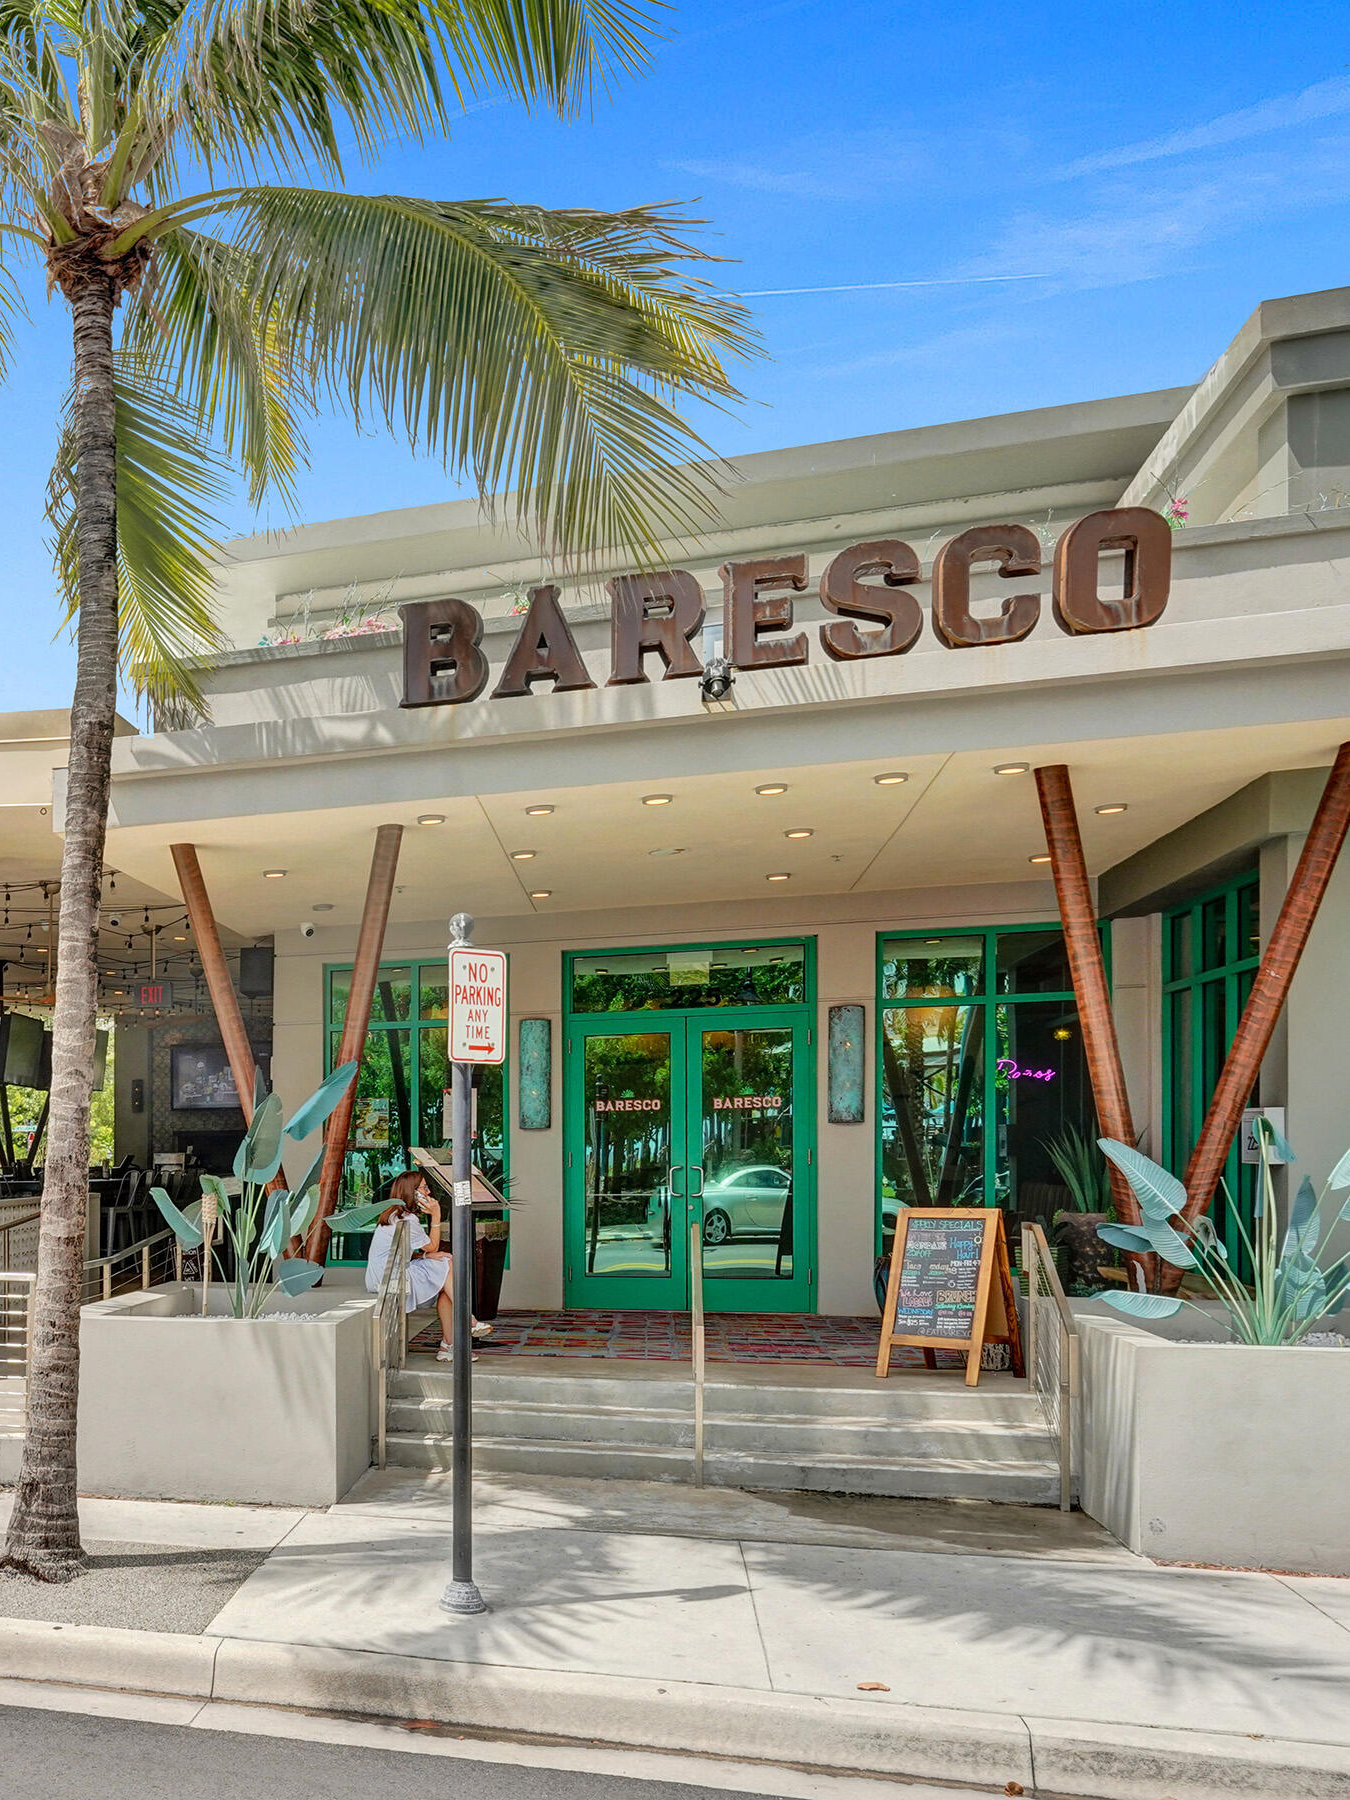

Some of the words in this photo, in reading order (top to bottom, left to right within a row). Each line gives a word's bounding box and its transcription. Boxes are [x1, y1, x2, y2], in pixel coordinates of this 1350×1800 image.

[398, 506, 1172, 709] BARESCO
[469, 962, 488, 983] NO
[141, 986, 163, 1005] EXIT
[454, 984, 501, 1007] PARKING
[467, 1009, 488, 1022] ANY
[465, 1025, 490, 1039] TIME
[596, 1099, 661, 1112] BARESCO
[713, 1096, 782, 1110] BARESCO
[939, 1220, 983, 1230] SPECIALS
